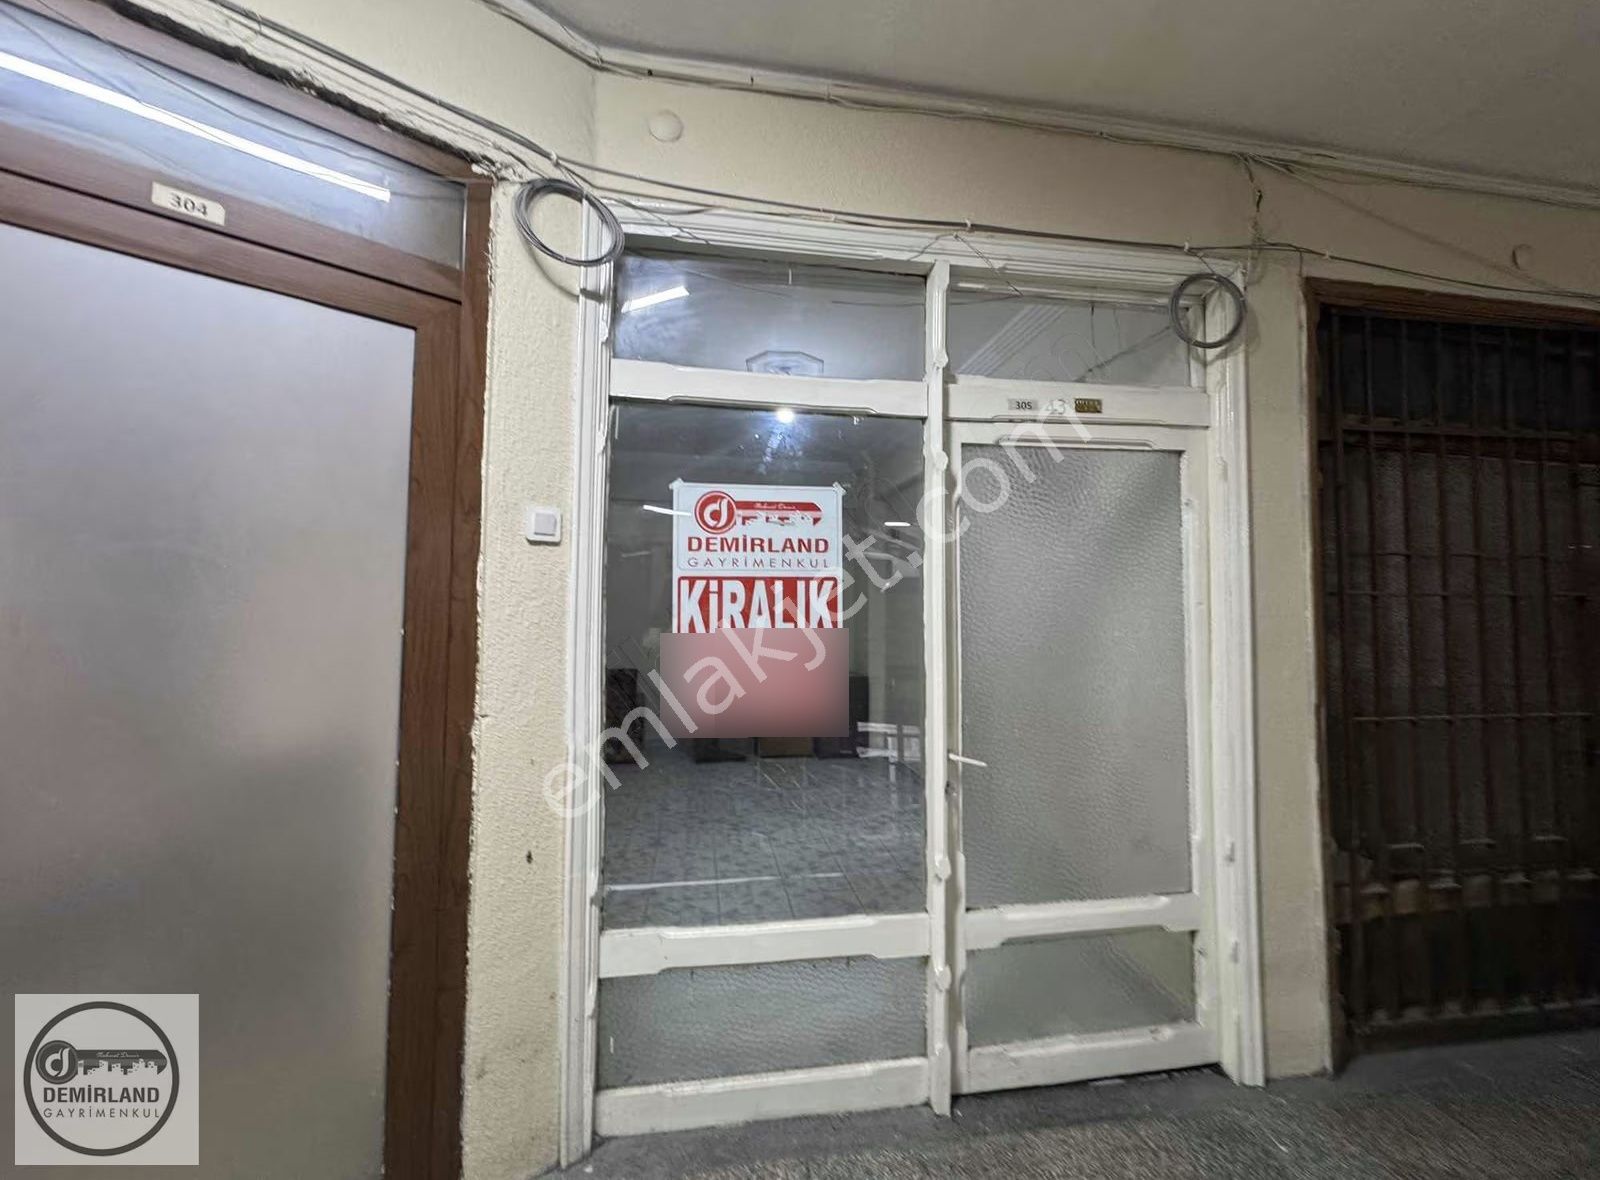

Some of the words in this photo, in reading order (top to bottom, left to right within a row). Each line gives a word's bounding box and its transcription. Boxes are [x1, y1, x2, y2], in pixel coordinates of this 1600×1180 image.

[168, 191, 208, 217] 304
[1015, 400, 1033, 410] 305
[687, 534, 829, 554] DEMİRLAND
[687, 556, 829, 569] GAYRİMENKUL
